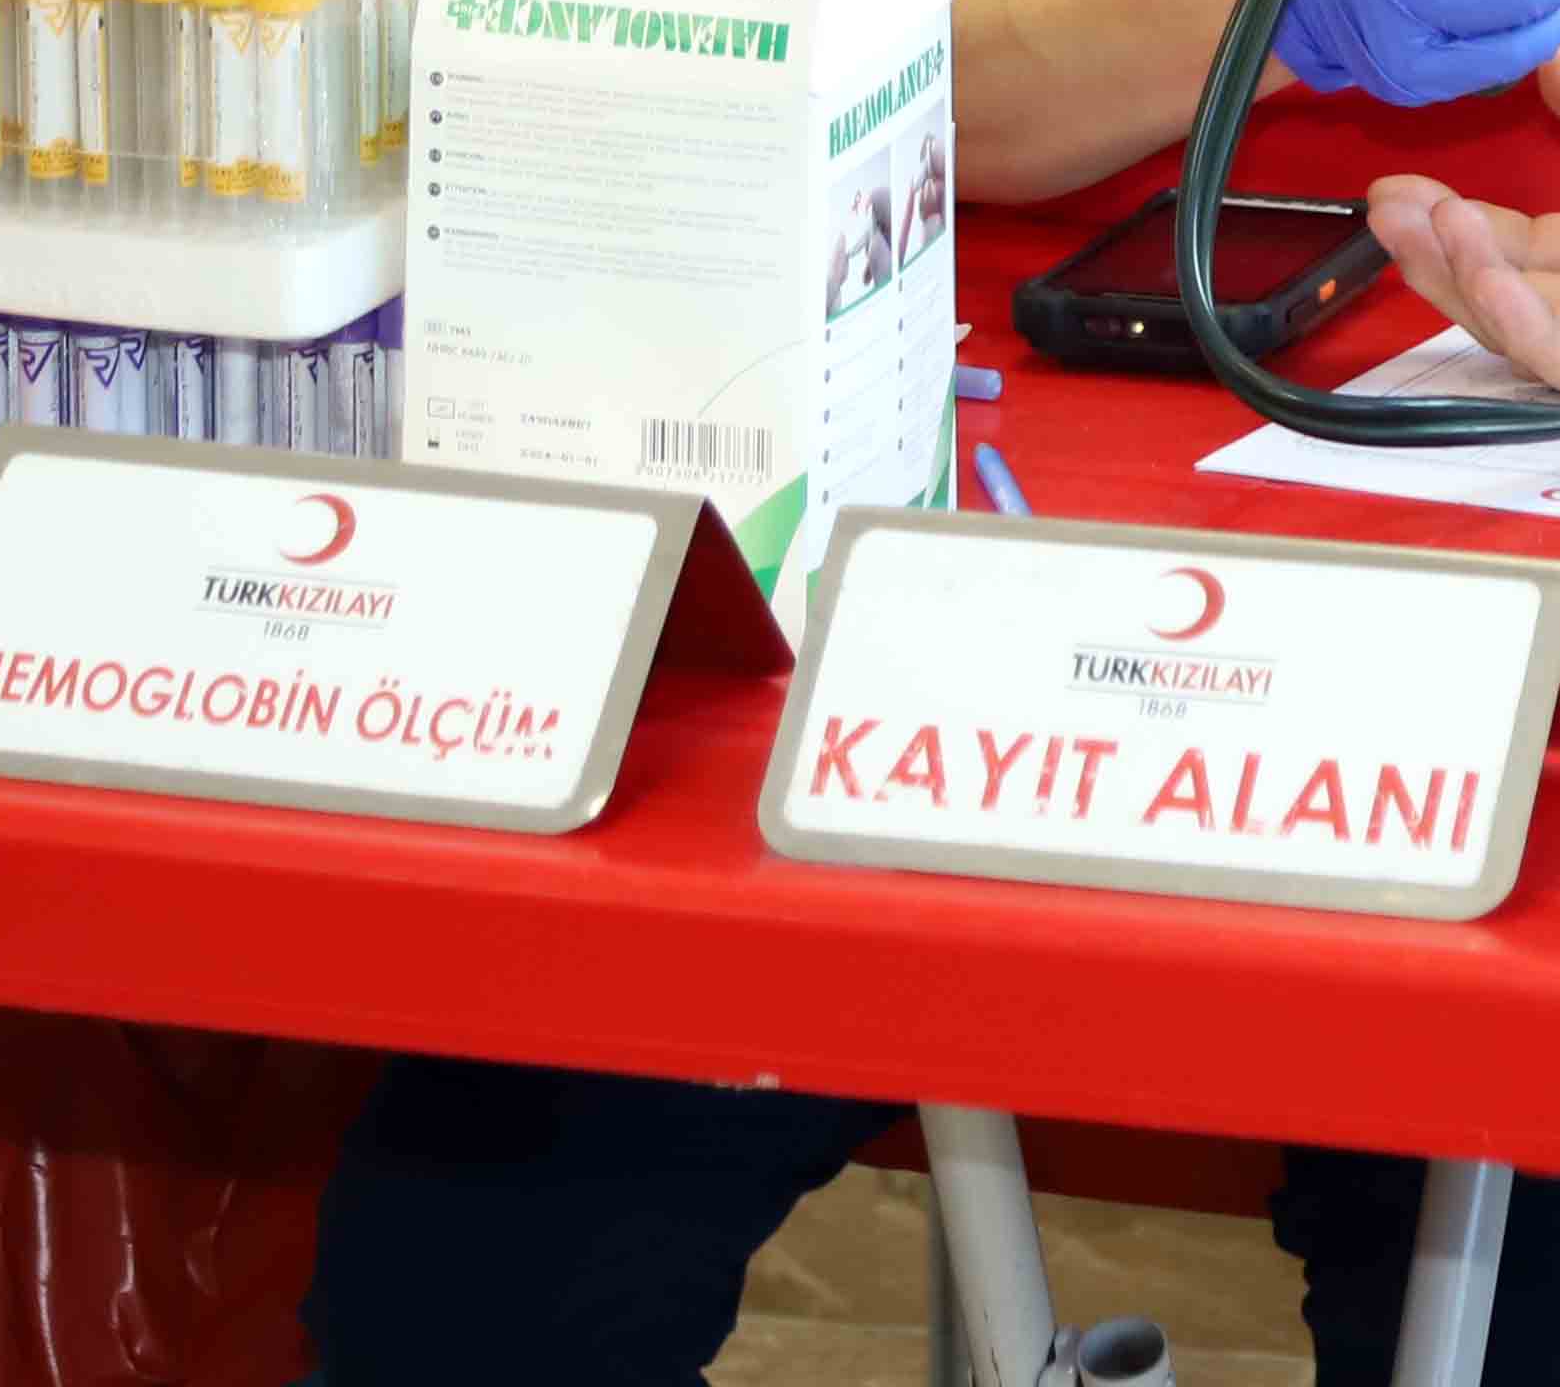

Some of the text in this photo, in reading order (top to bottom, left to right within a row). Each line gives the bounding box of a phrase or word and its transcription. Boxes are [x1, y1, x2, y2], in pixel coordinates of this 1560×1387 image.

[356, 676, 561, 762] ÖLÇÜM
[808, 715, 1481, 853] KAYIT ALANI
